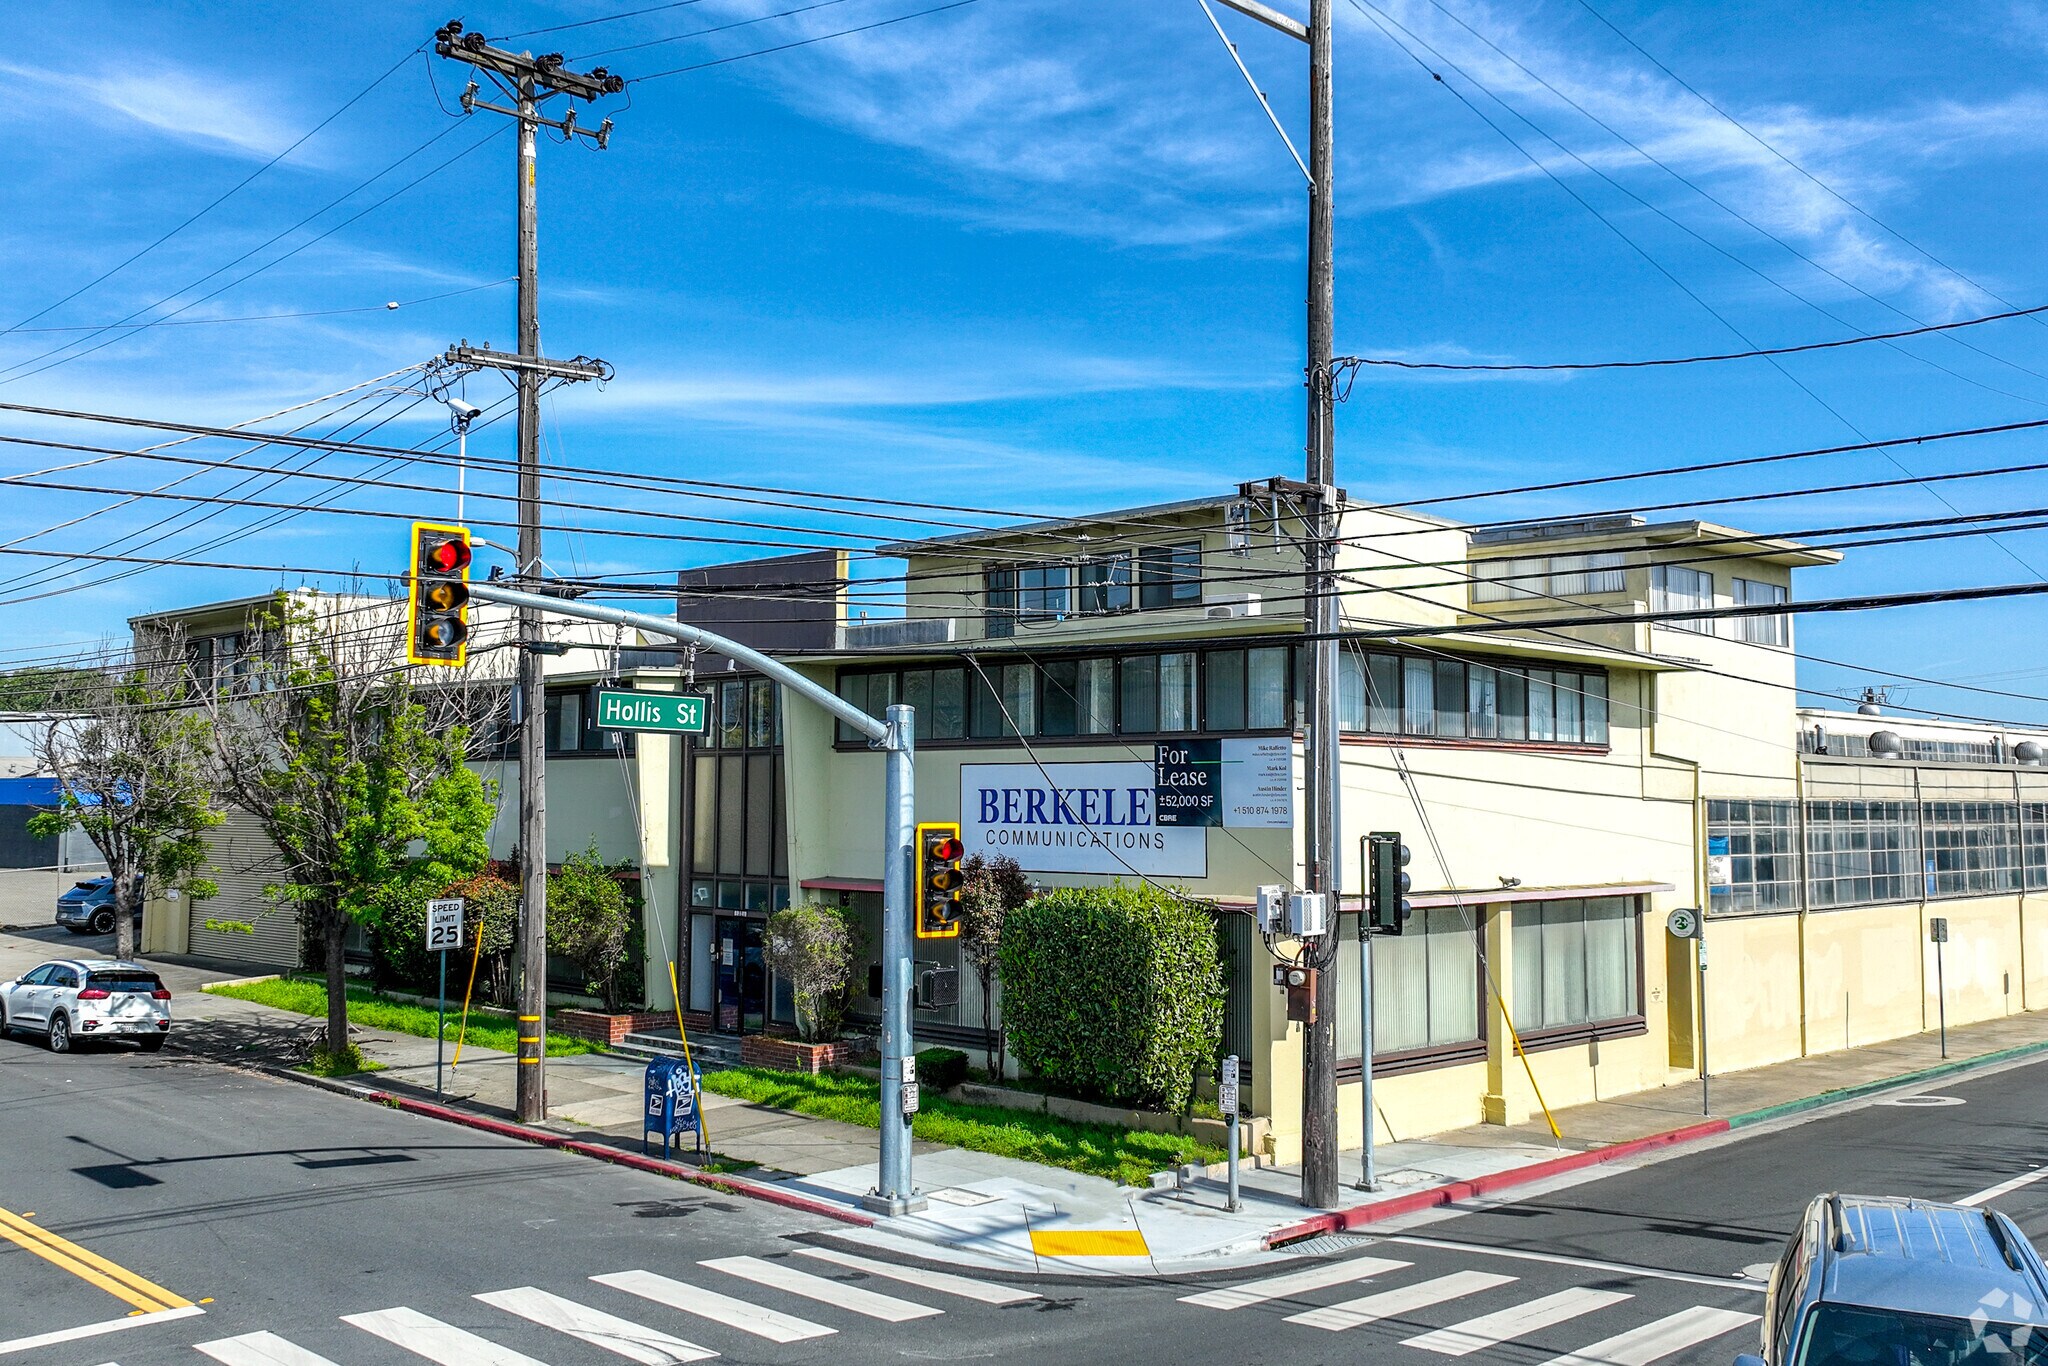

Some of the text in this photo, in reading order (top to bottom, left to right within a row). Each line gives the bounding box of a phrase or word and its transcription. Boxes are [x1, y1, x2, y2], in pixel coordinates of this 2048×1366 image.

[606, 699, 697, 725] Hollis St
[1158, 745, 1189, 765] For
[1158, 767, 1208, 786] Lease
[978, 788, 1156, 826] BERKELE
[1200, 795, 1214, 807] SF
[1242, 806, 1255, 815] 510
[1256, 806, 1270, 815] 874
[1271, 806, 1288, 815] 1978
[1159, 814, 1178, 822] CBRE
[986, 829, 1165, 850] COMMUNICATIONS
[432, 903, 460, 913] SPEED
[434, 914, 456, 924] LIMIT
[431, 925, 458, 945] 25
